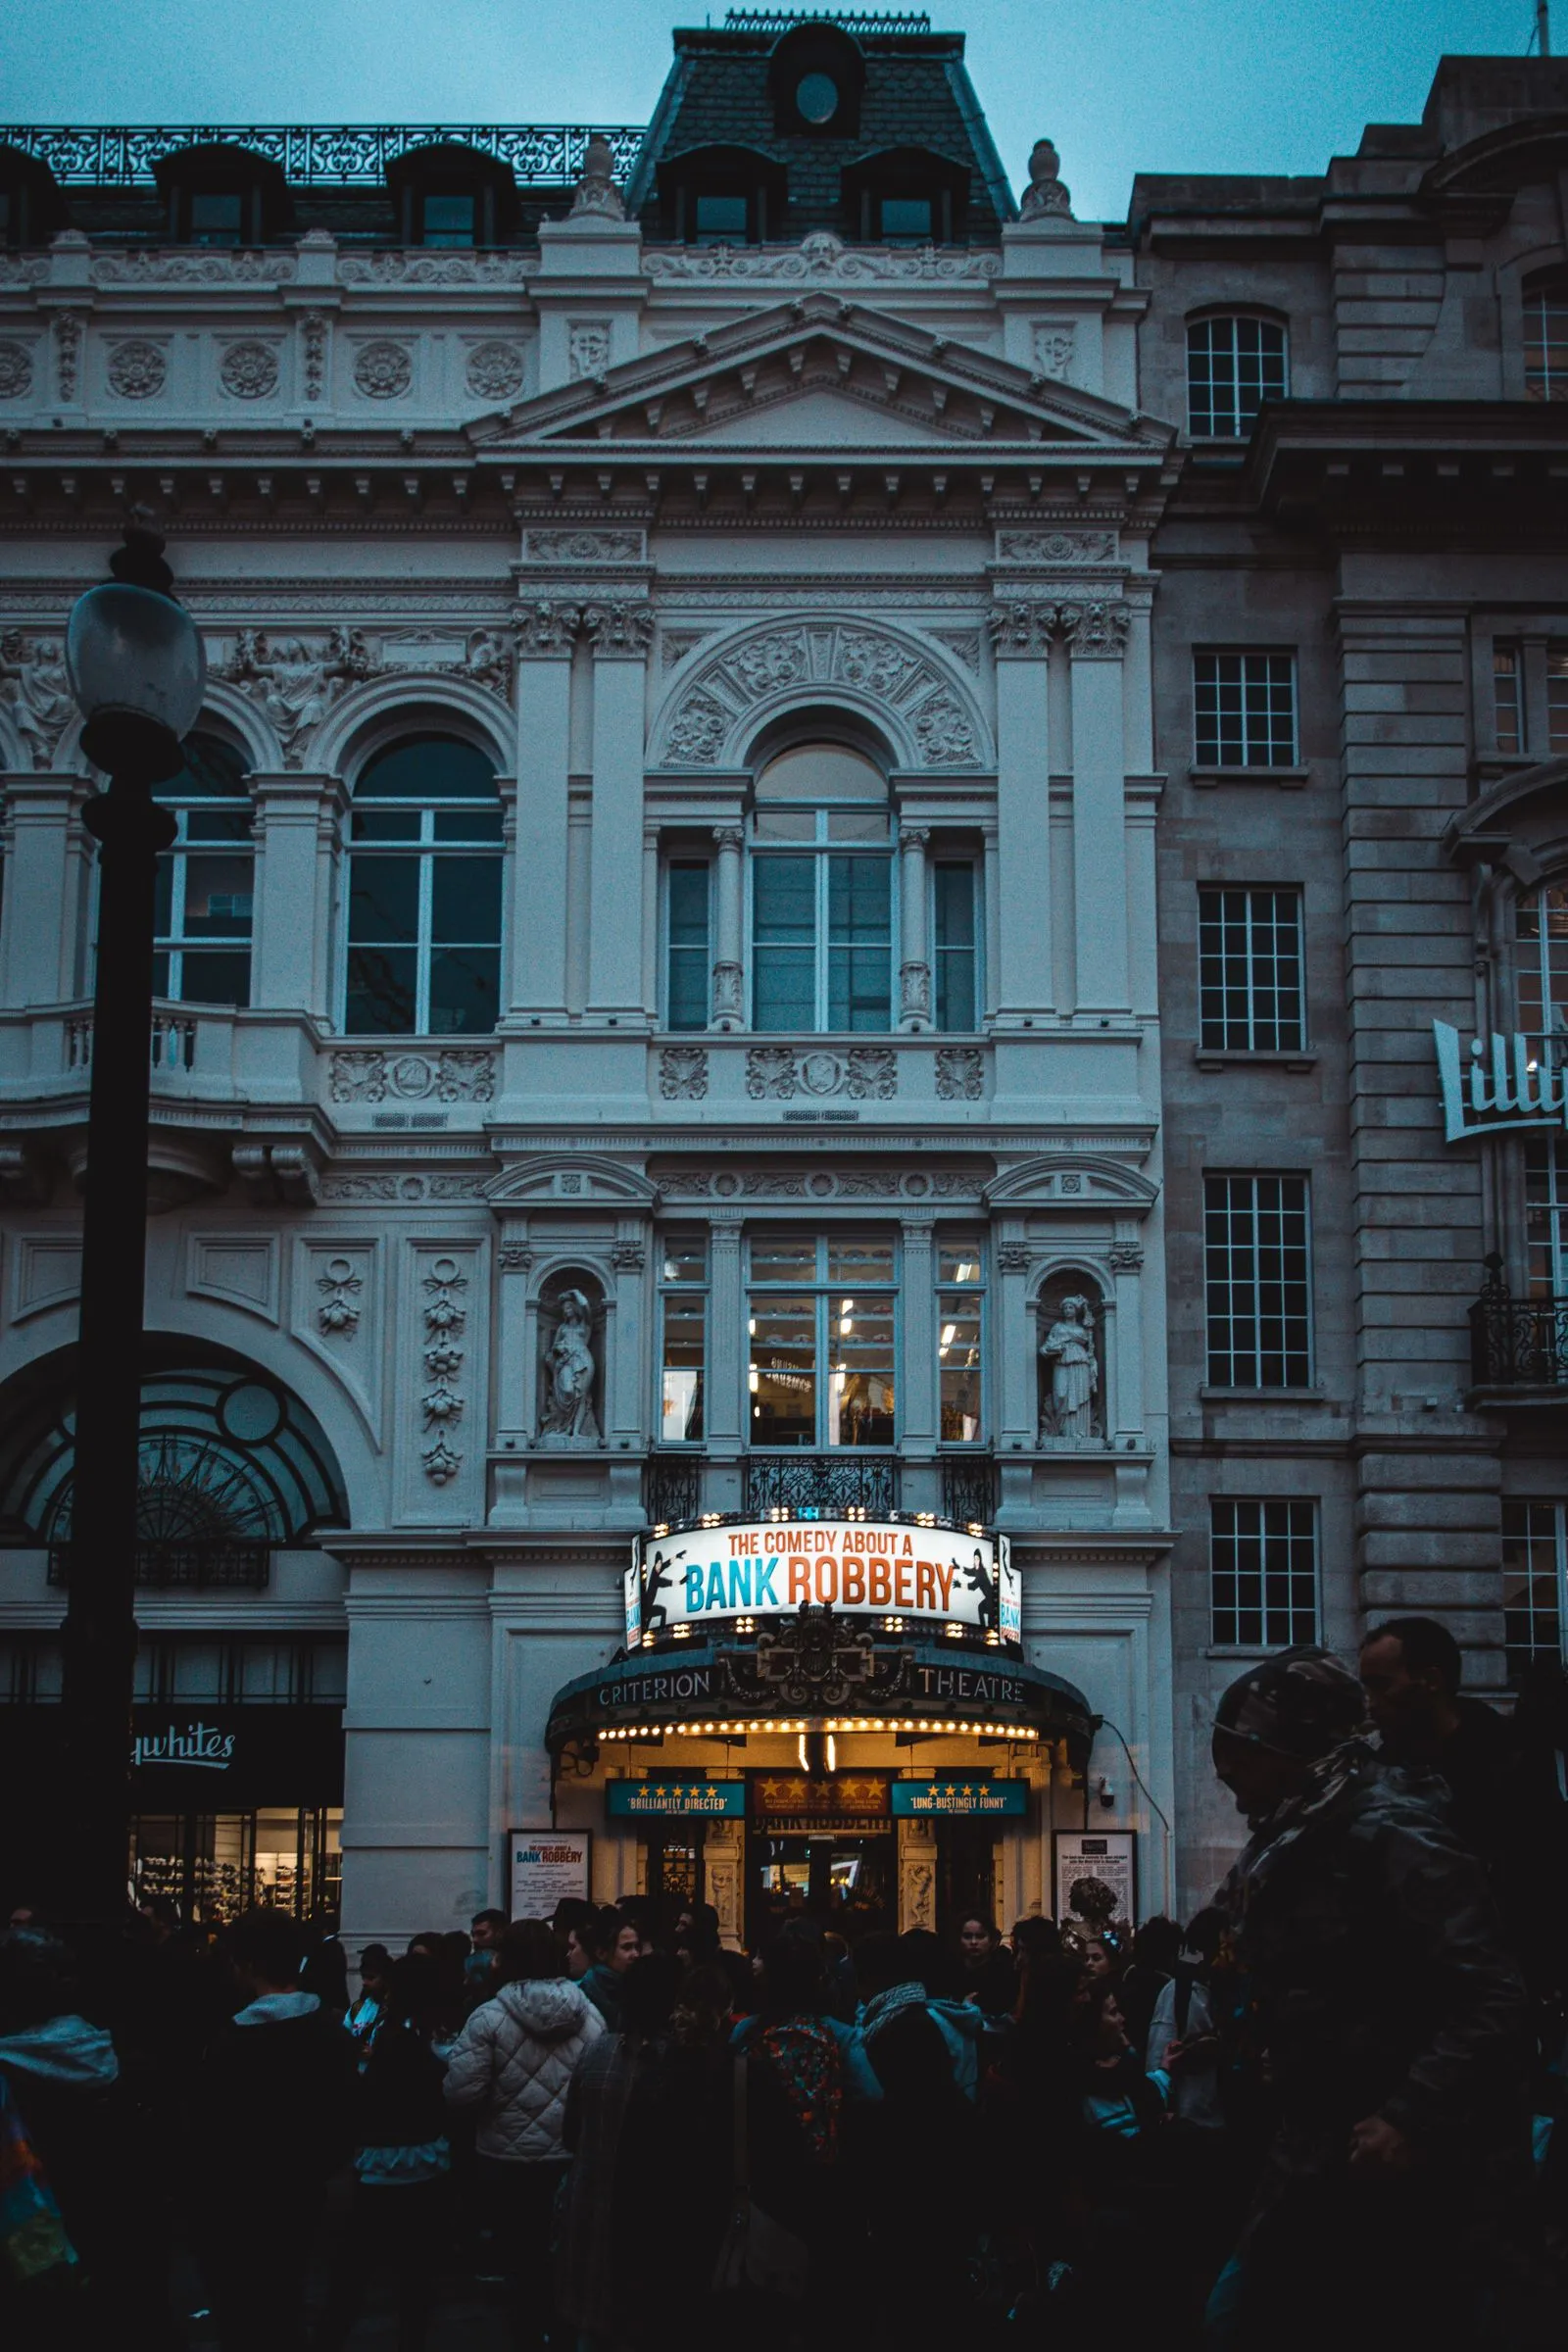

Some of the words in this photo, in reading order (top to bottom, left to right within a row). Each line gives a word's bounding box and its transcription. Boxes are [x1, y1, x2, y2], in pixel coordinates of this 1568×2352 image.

[728, 1534, 760, 1556] THE
[764, 1530, 837, 1554] COMEDY
[842, 1531, 899, 1555] ABOUT
[902, 1534, 913, 1556] A
[686, 1556, 779, 1613] BANK
[787, 1555, 955, 1612] ROBBERY
[599, 1670, 710, 1706] CRITERION
[917, 1668, 1024, 1702] THEATRE
[516, 1851, 541, 1863] BANK
[542, 1851, 582, 1863] ROBBERY
